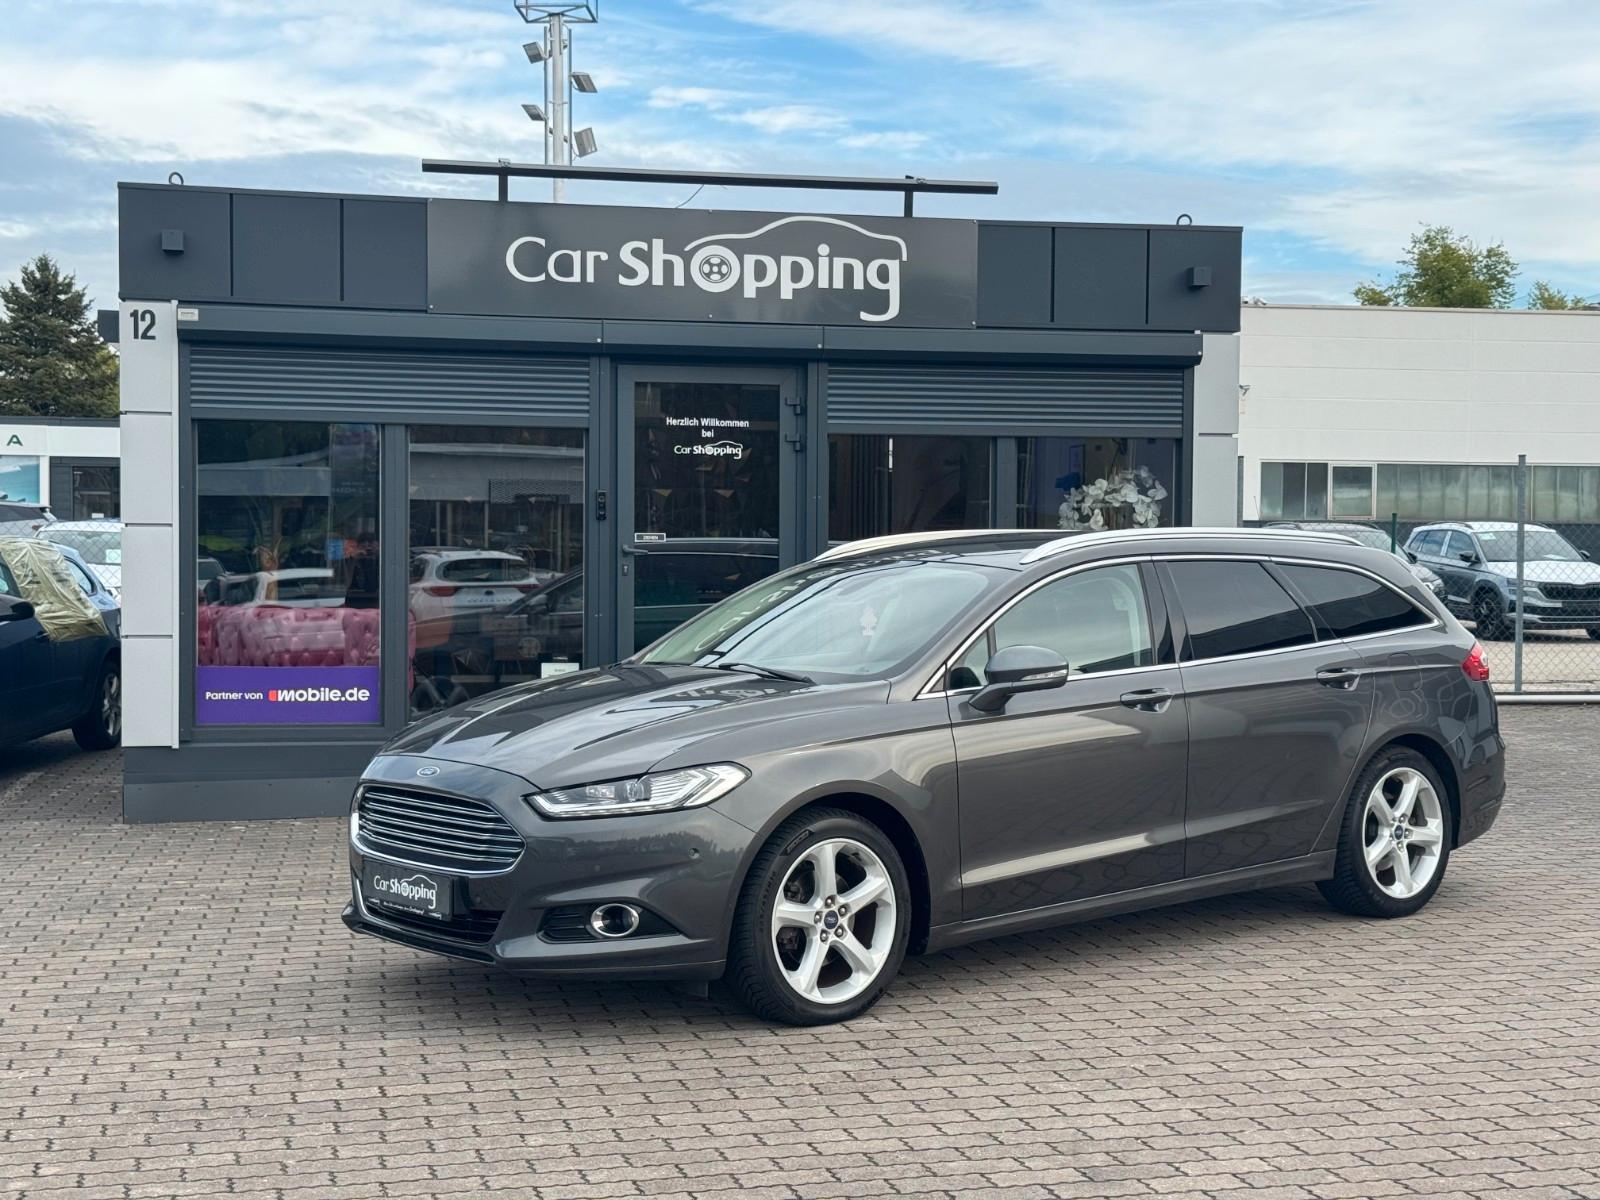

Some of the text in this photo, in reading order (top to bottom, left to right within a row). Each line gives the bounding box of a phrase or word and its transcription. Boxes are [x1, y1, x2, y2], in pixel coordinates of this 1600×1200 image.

[505, 236, 901, 322] Car Shopping
[129, 309, 156, 340] 12
[666, 416, 749, 428] Herzlich Willkommen
[701, 429, 714, 438] bei
[674, 444, 742, 460] Car Shopping
[205, 687, 370, 702] Partner von mobile.de
[373, 875, 389, 891] Car
[390, 878, 437, 910] Shopping
